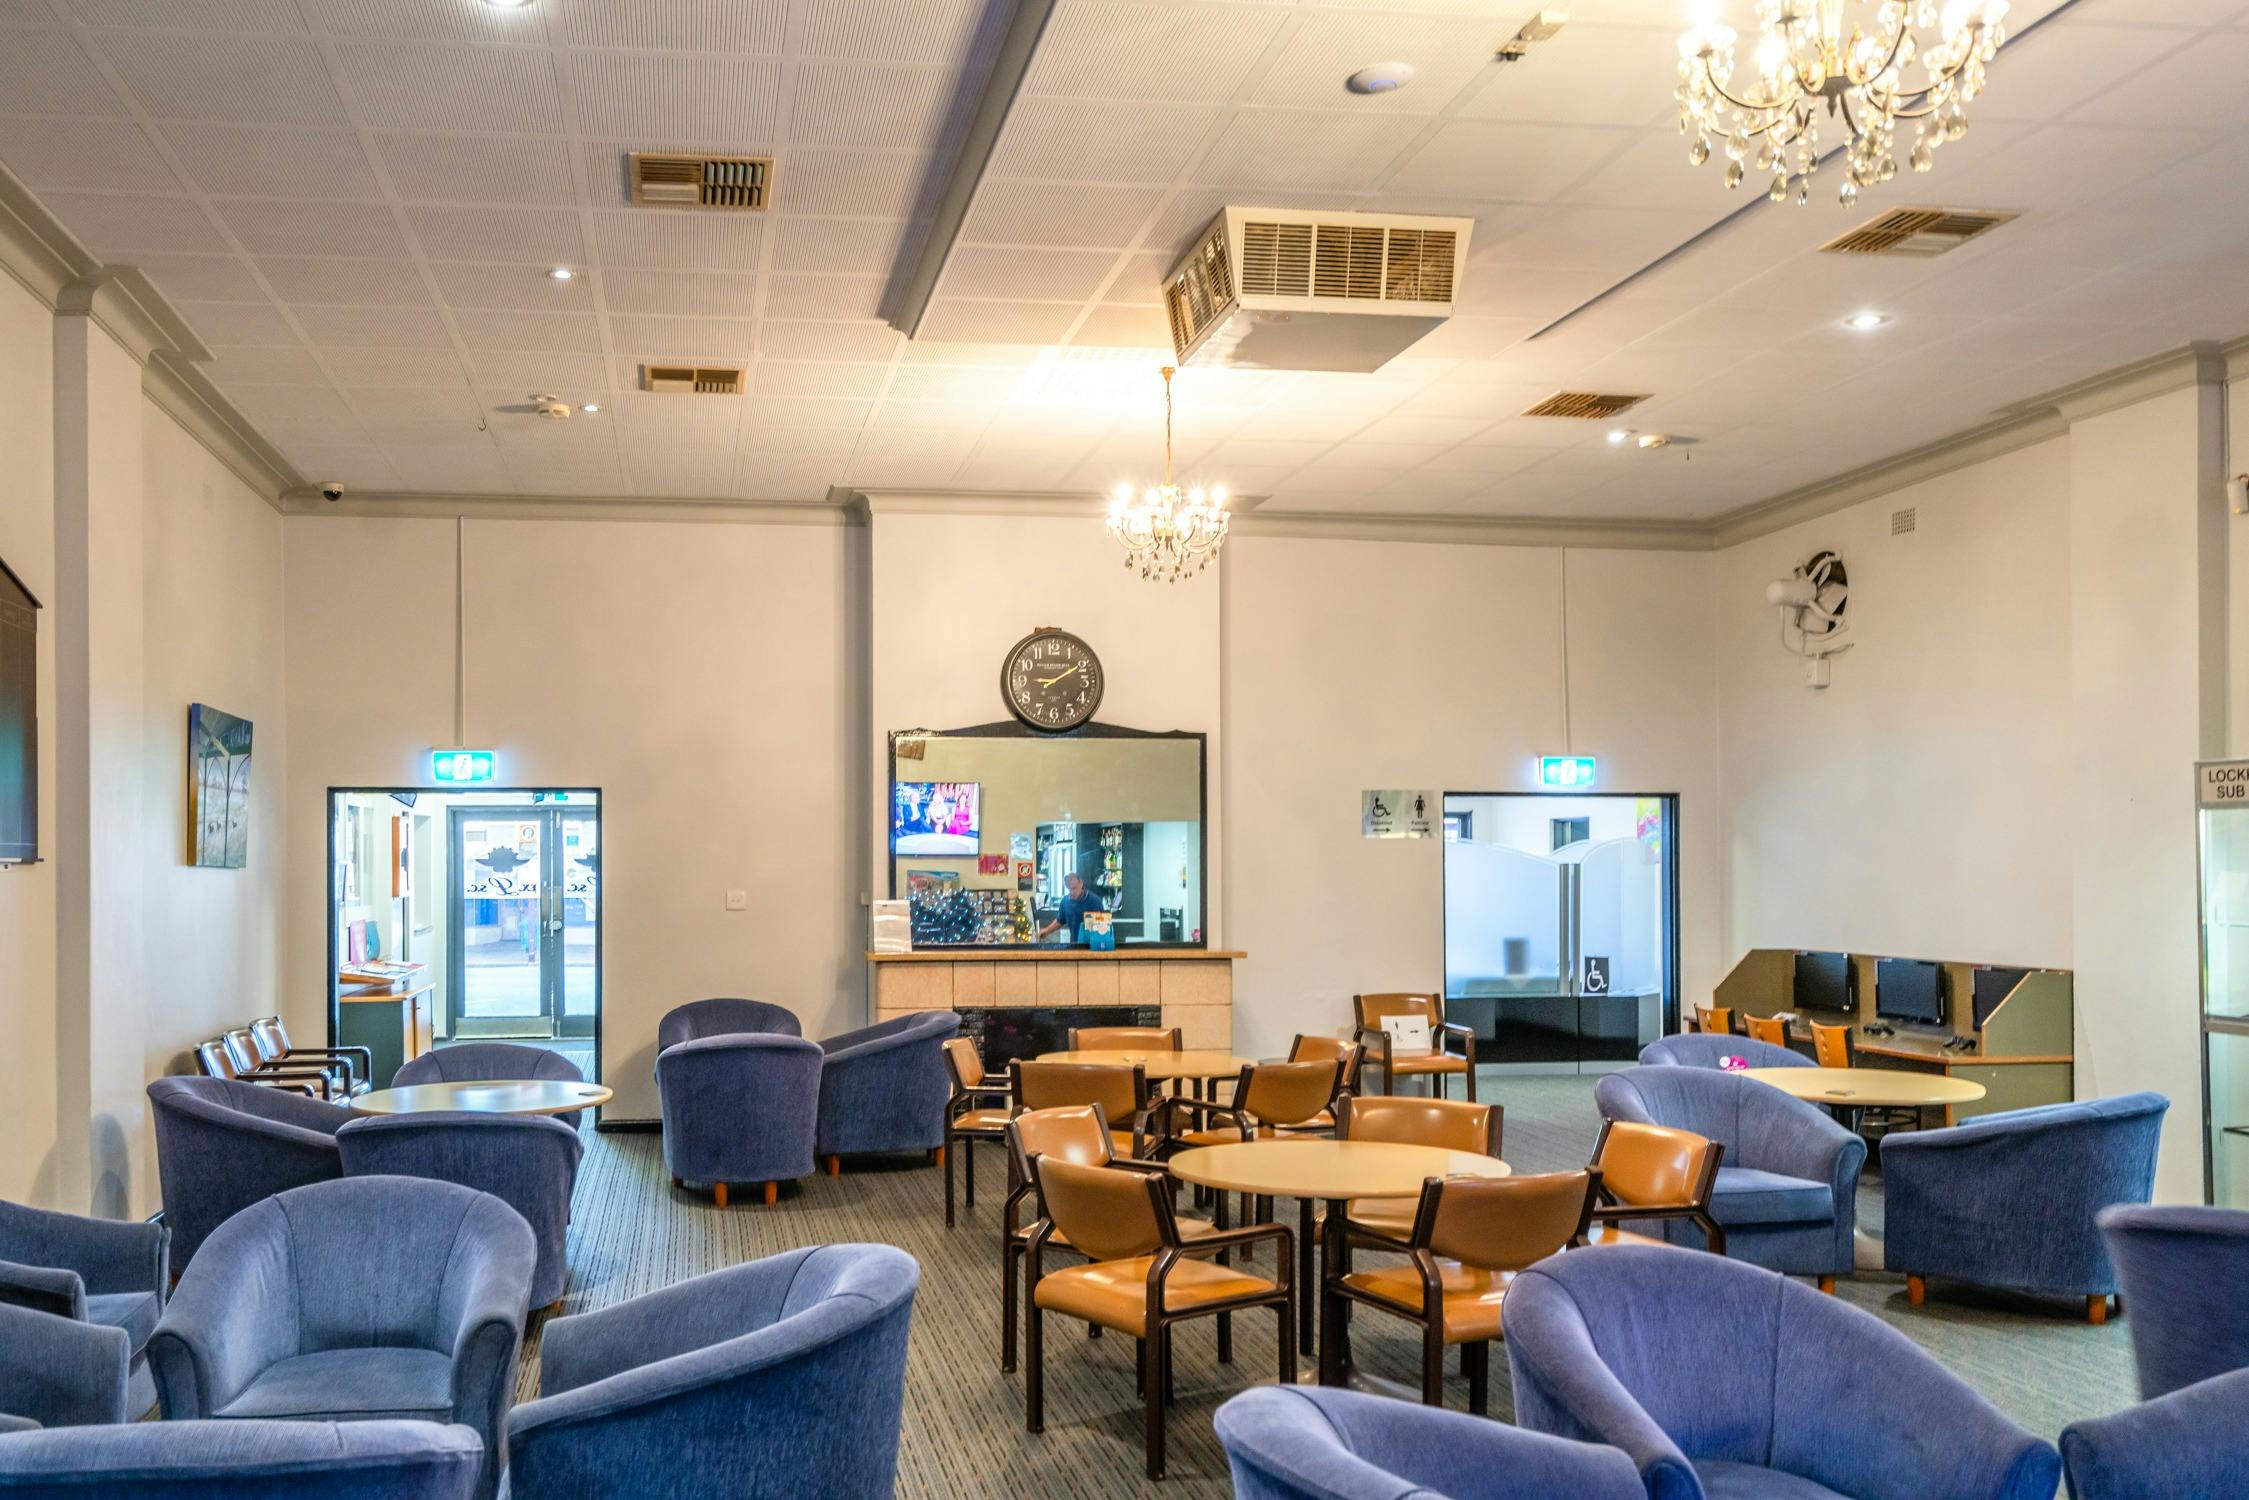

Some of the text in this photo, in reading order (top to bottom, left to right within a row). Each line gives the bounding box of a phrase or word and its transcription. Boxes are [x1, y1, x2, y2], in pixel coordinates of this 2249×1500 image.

[1034, 647, 1042, 660] 11
[1048, 643, 1060, 656] 12
[1021, 659, 1033, 672] 10
[1078, 660, 1087, 672] 2
[1018, 675, 1027, 688] 9
[1080, 675, 1089, 688] 3
[1021, 691, 1031, 704] 8
[1076, 691, 1086, 704] 4
[1035, 703, 1044, 716] 7
[1049, 707, 1059, 720] 6
[1065, 703, 1074, 716] 5
[2208, 768, 2249, 783] LOCK
[2216, 785, 2245, 799] SUB
